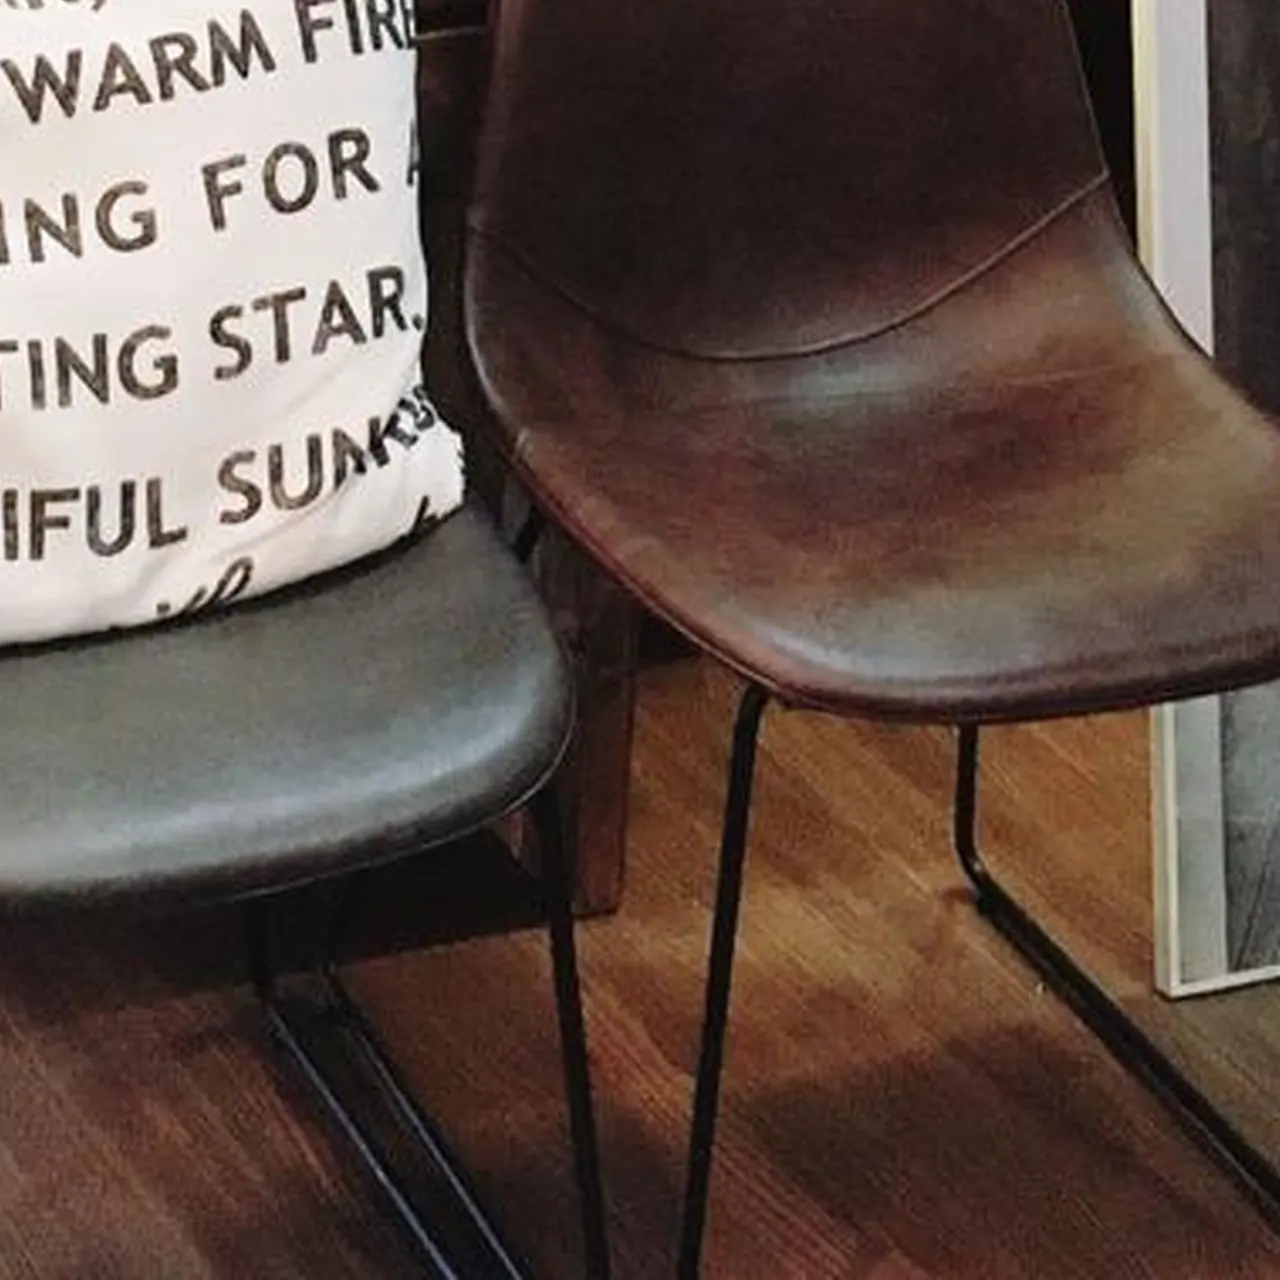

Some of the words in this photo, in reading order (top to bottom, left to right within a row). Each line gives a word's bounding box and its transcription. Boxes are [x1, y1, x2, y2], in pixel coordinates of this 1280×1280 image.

[0, 9, 277, 126] WARM
[200, 128, 381, 233] FOR
[210, 265, 426, 382] STAR.
